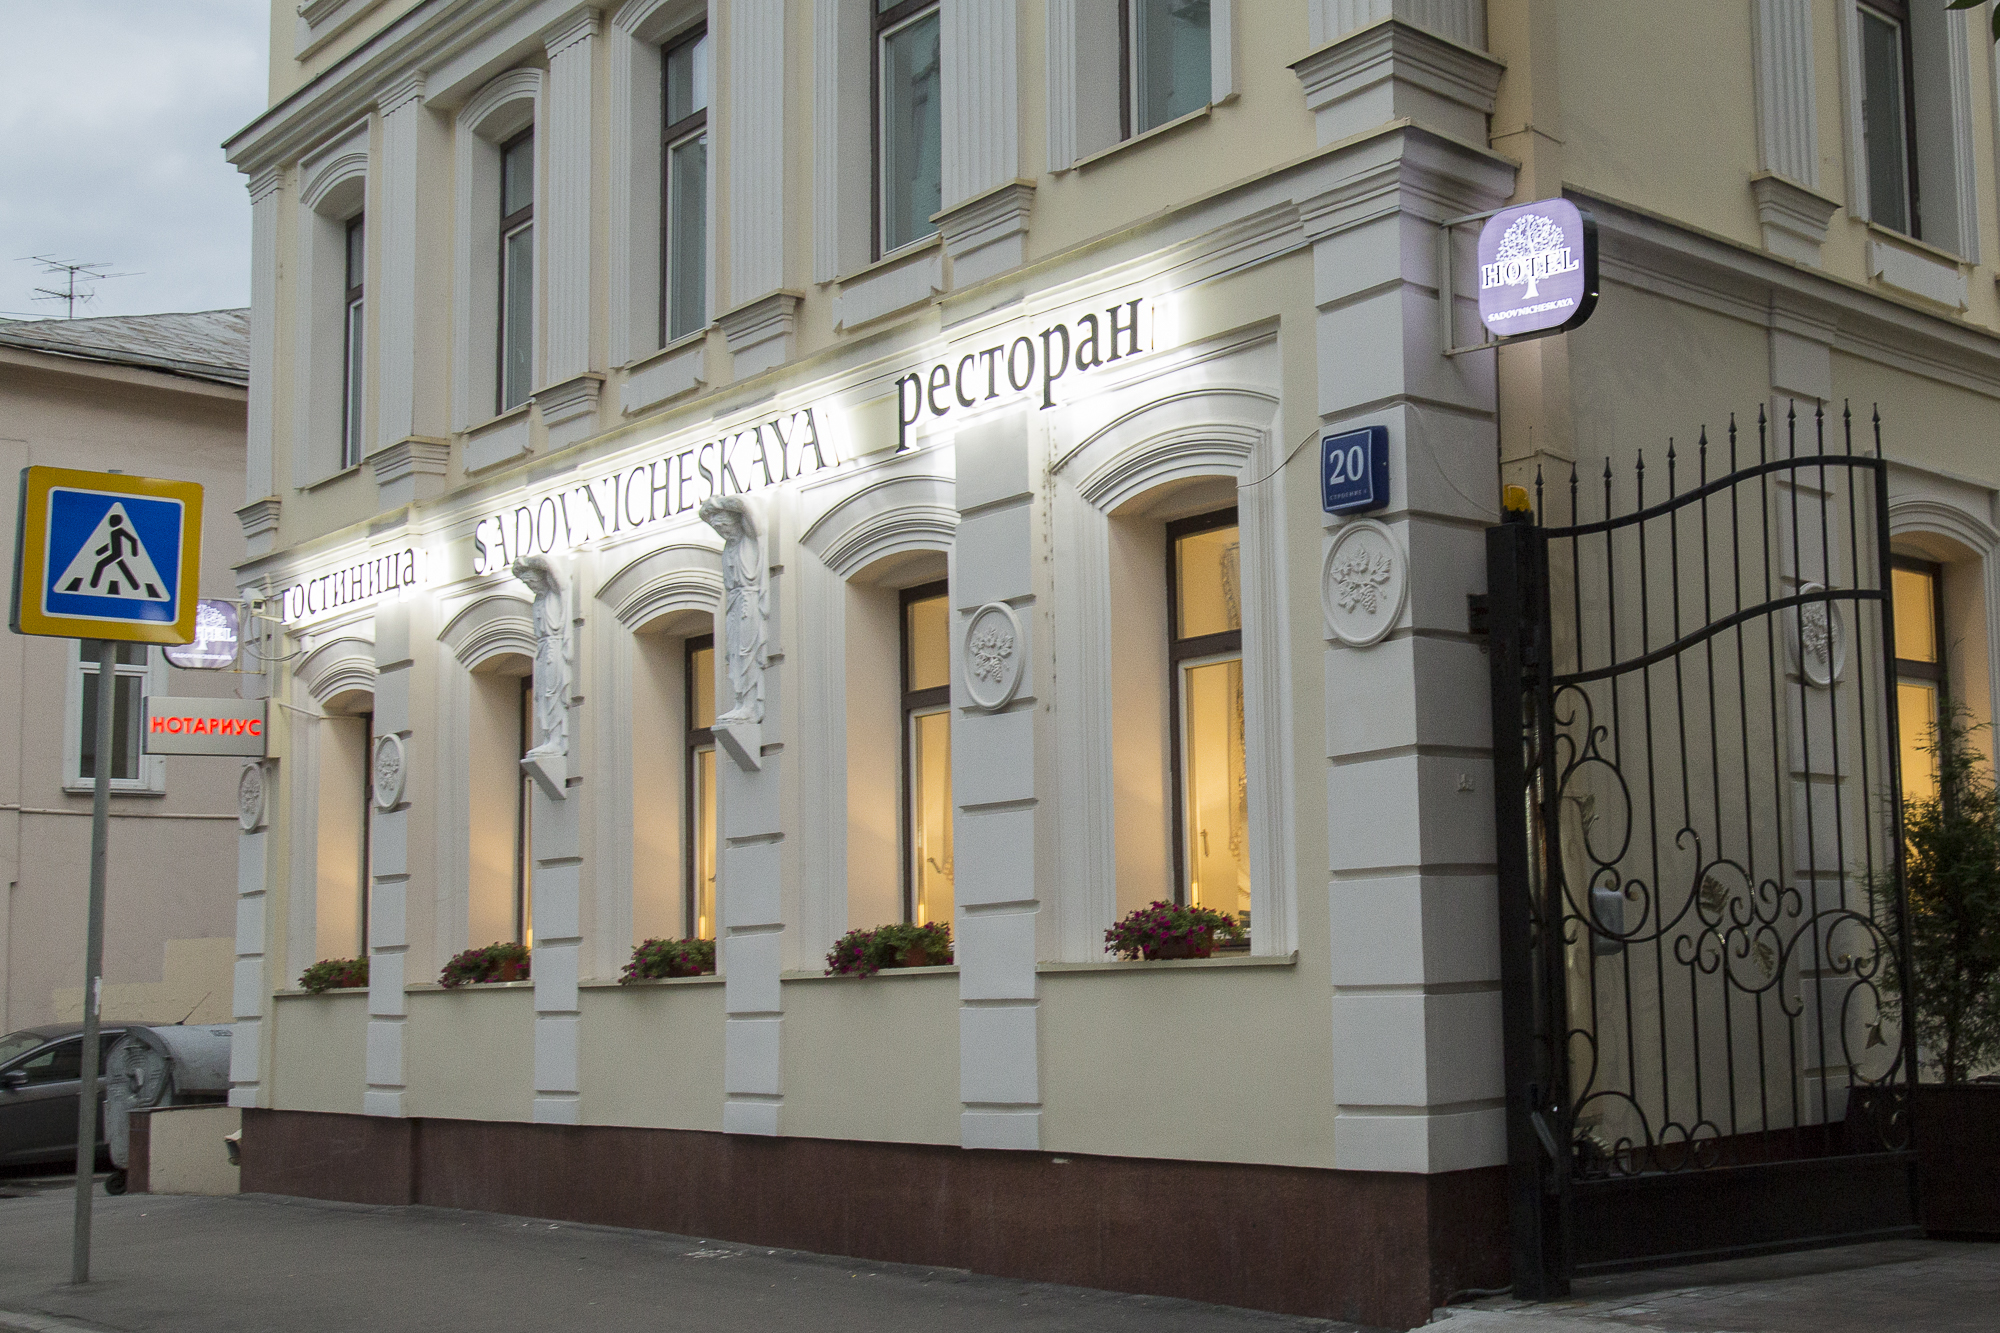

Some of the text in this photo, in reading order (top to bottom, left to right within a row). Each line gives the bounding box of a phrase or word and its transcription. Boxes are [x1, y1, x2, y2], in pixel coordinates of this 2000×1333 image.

[1481, 247, 1580, 289] HOTEL
[1487, 297, 1574, 323] SADOVNICHESKAYA
[895, 297, 1144, 455] ресторан
[1329, 445, 1365, 486] 20
[474, 407, 832, 576] SADOVNICHESKAYA
[280, 547, 417, 624] гостиница
[149, 716, 262, 736] НОТАРИУС
